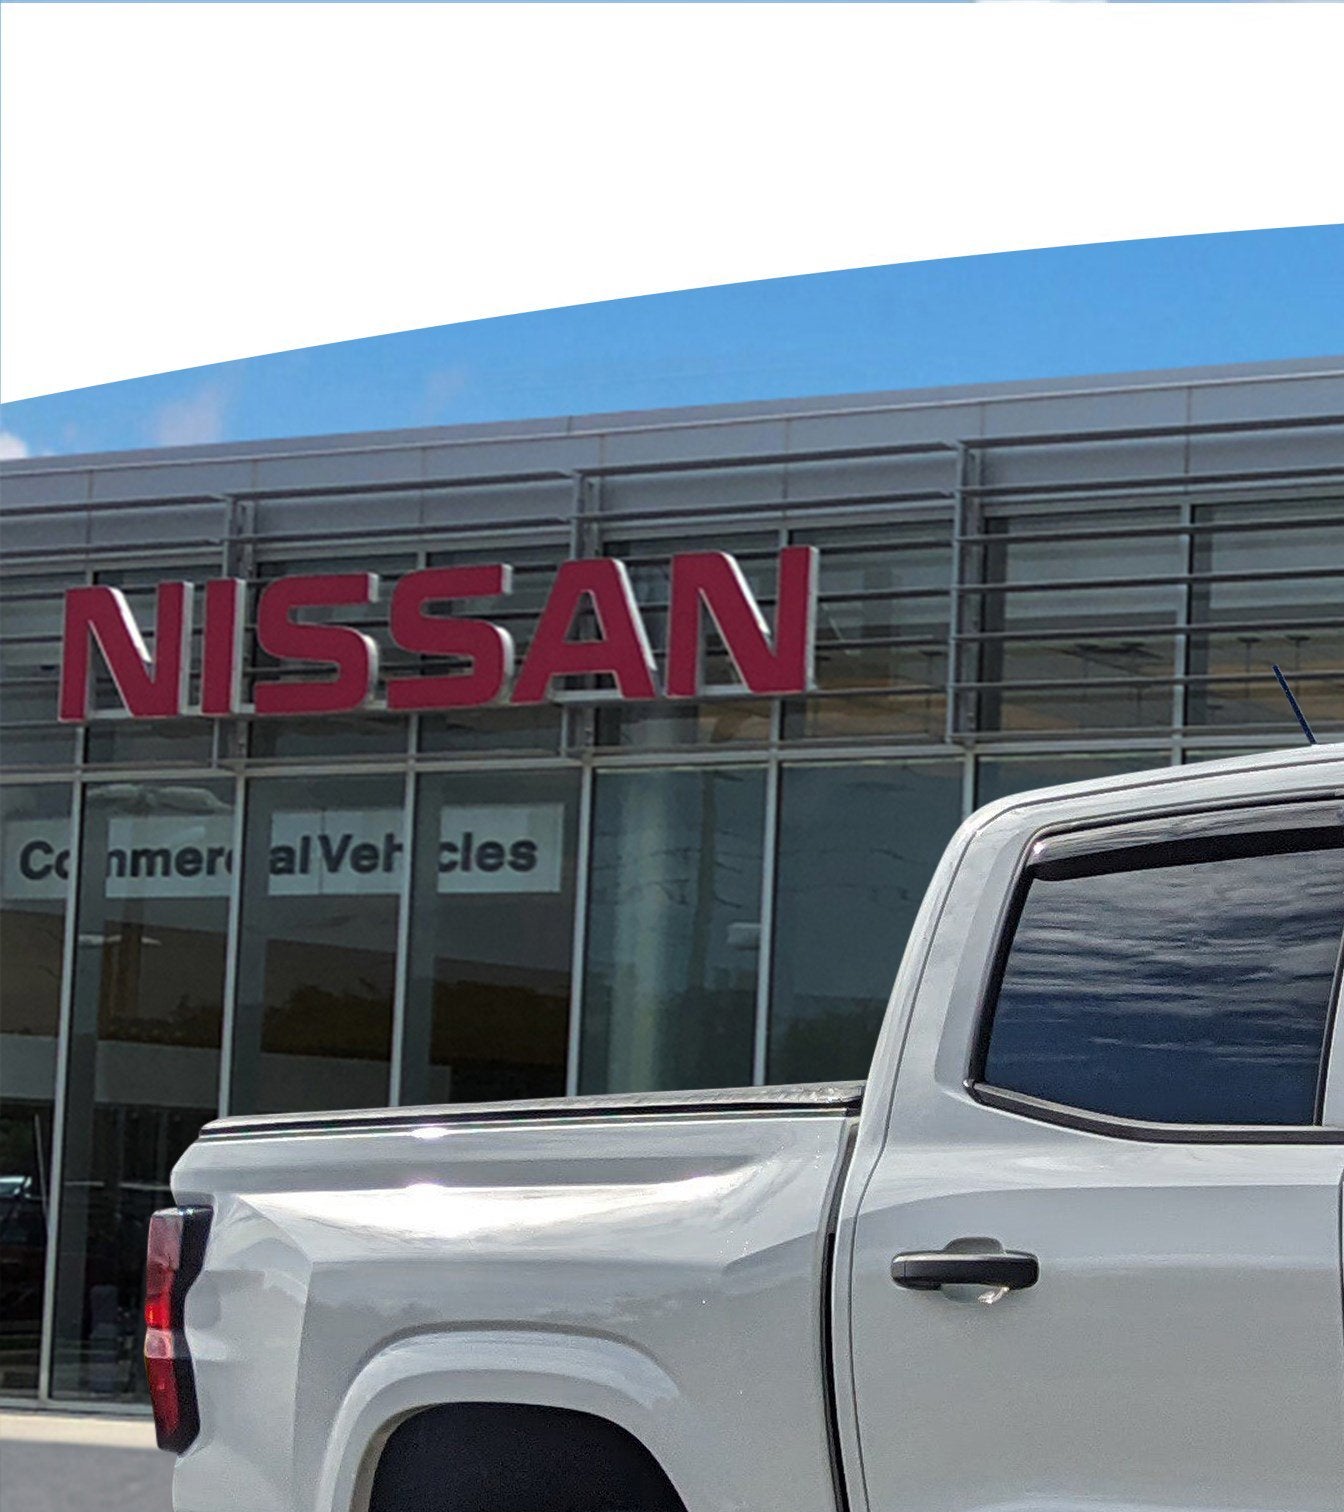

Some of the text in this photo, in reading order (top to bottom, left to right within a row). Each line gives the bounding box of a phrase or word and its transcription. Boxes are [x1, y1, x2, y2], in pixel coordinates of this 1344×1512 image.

[57, 545, 819, 723] NISSAN
[19, 831, 538, 880] Commeral Vehcles
